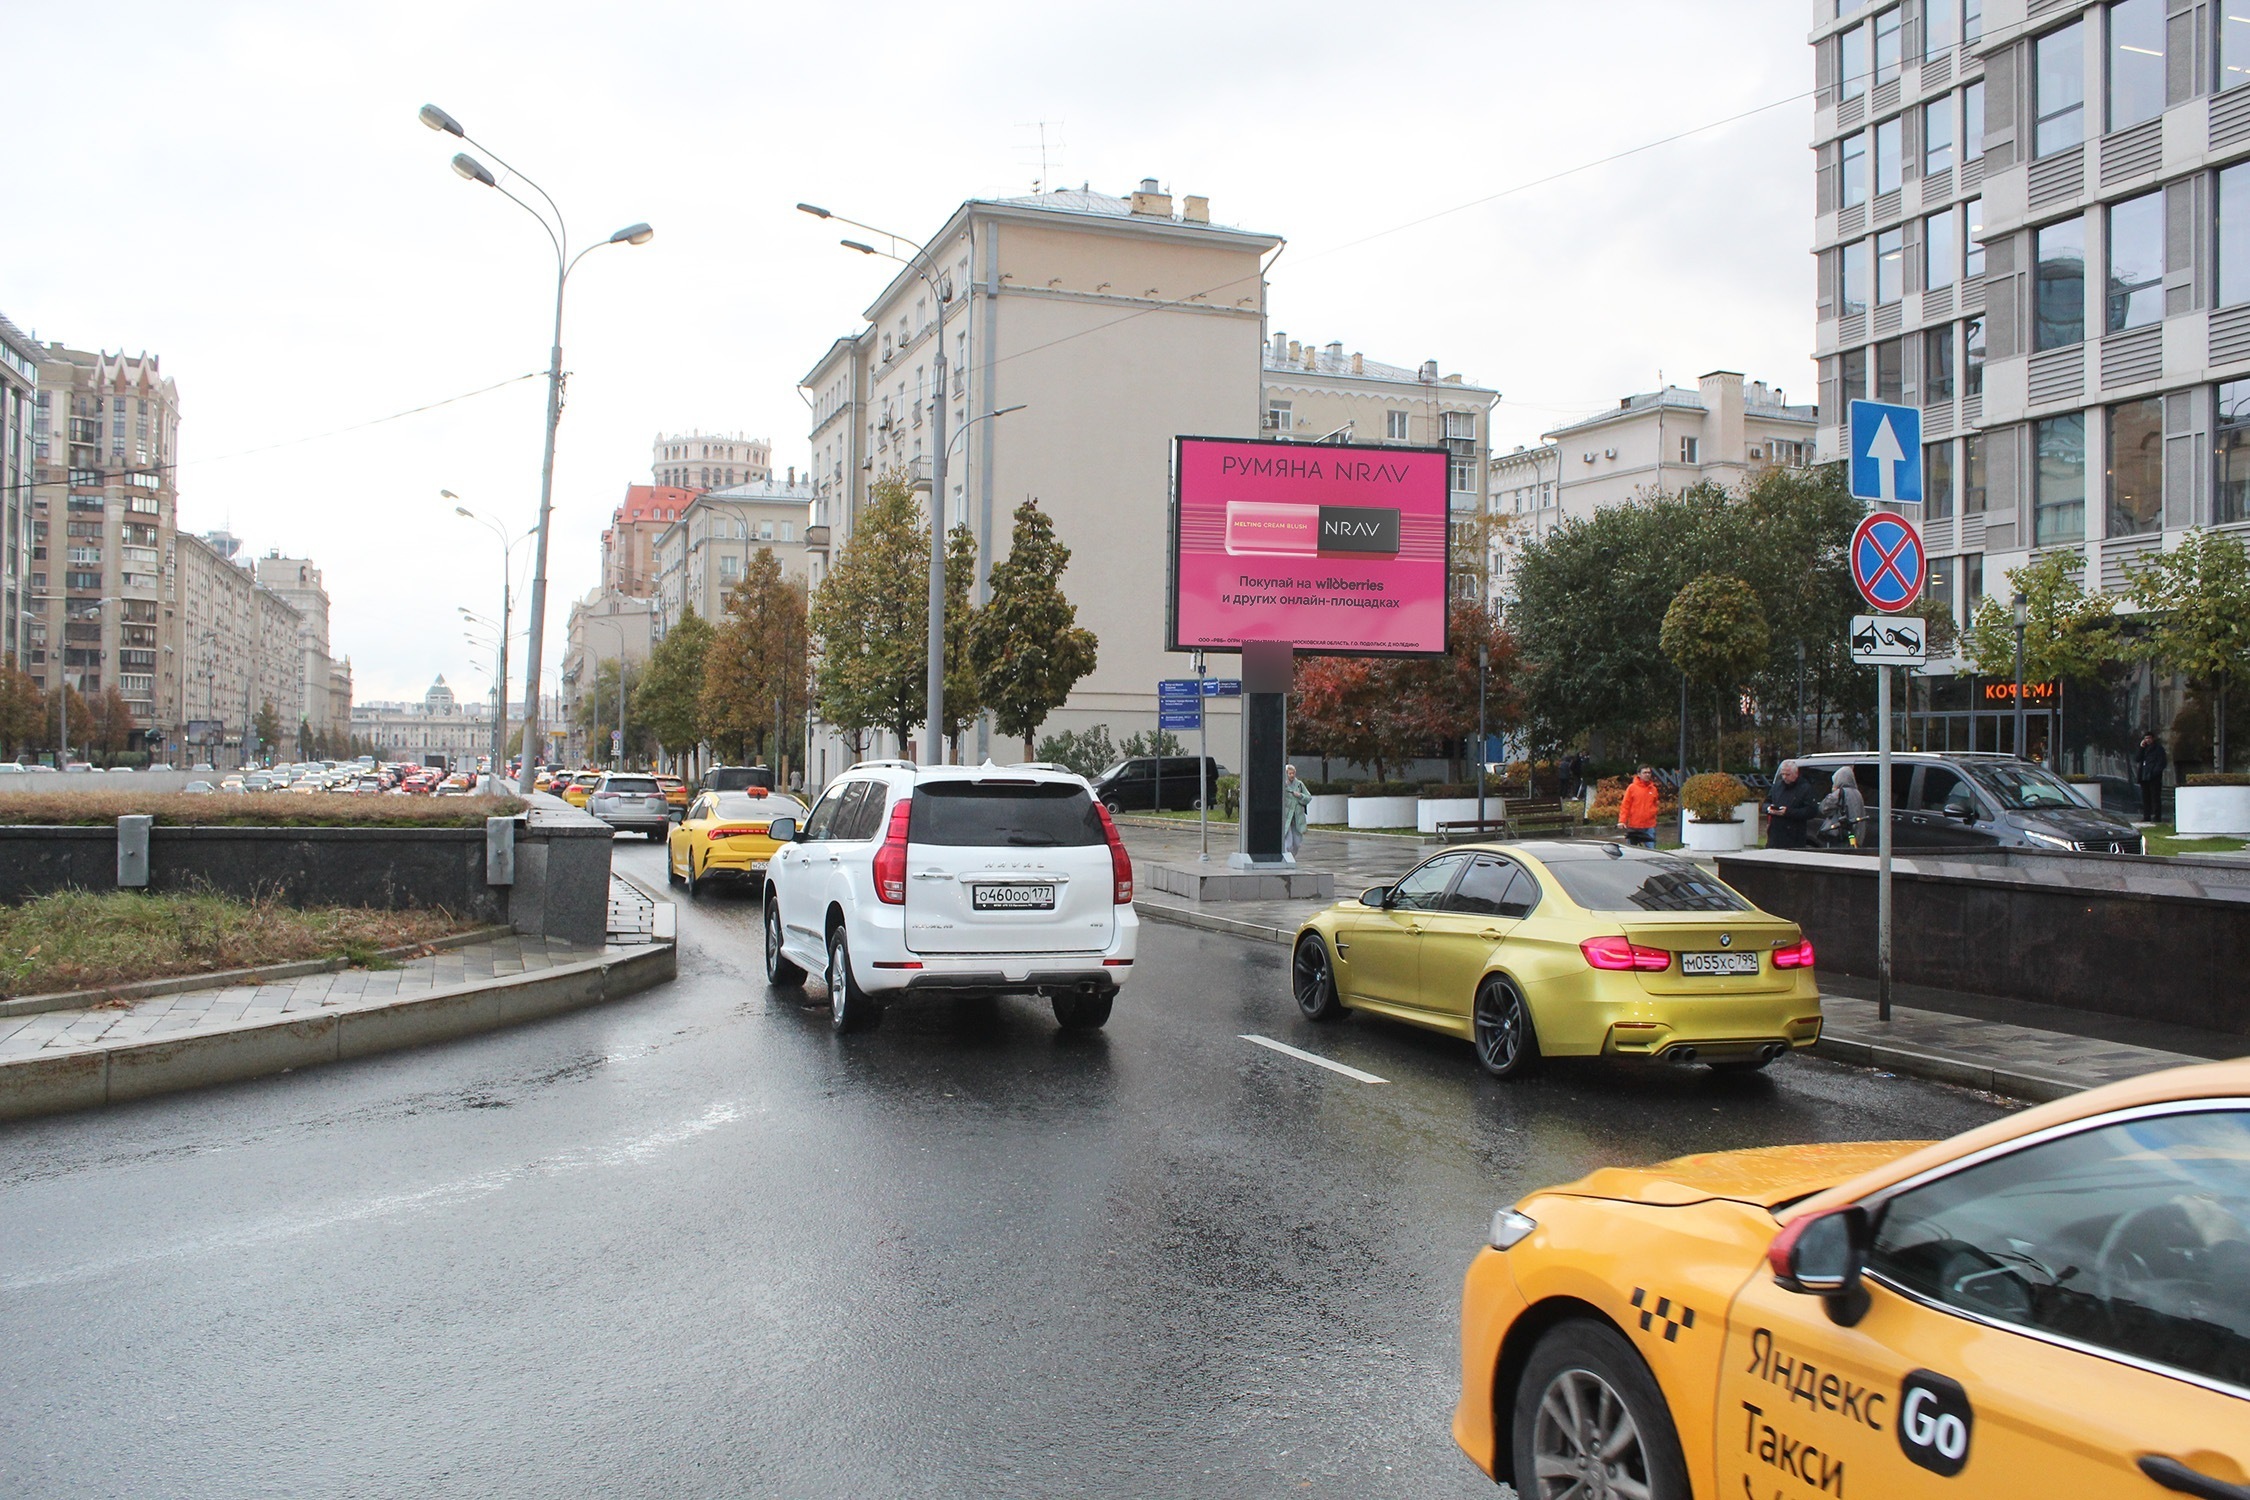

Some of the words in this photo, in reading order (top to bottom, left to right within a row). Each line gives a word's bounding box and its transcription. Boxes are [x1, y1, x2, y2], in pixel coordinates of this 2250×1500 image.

[1222, 456, 1323, 480] РУМЯНА
[1335, 461, 1410, 483] NRAV
[1325, 520, 1380, 537] NRAV
[1239, 575, 1294, 590] Покупай
[1296, 579, 1312, 589] на
[1315, 577, 1385, 592] wildberries
[1222, 594, 1231, 603] и
[1233, 593, 1277, 606] других
[1279, 594, 1400, 609] онлайн-площадках
[1032, 888, 1051, 898] 177
[1736, 954, 1754, 966] 799
[1746, 1327, 1887, 1431] Яндекс
[1903, 1386, 1967, 1460] Go
[1741, 1400, 1844, 1500] Такси
